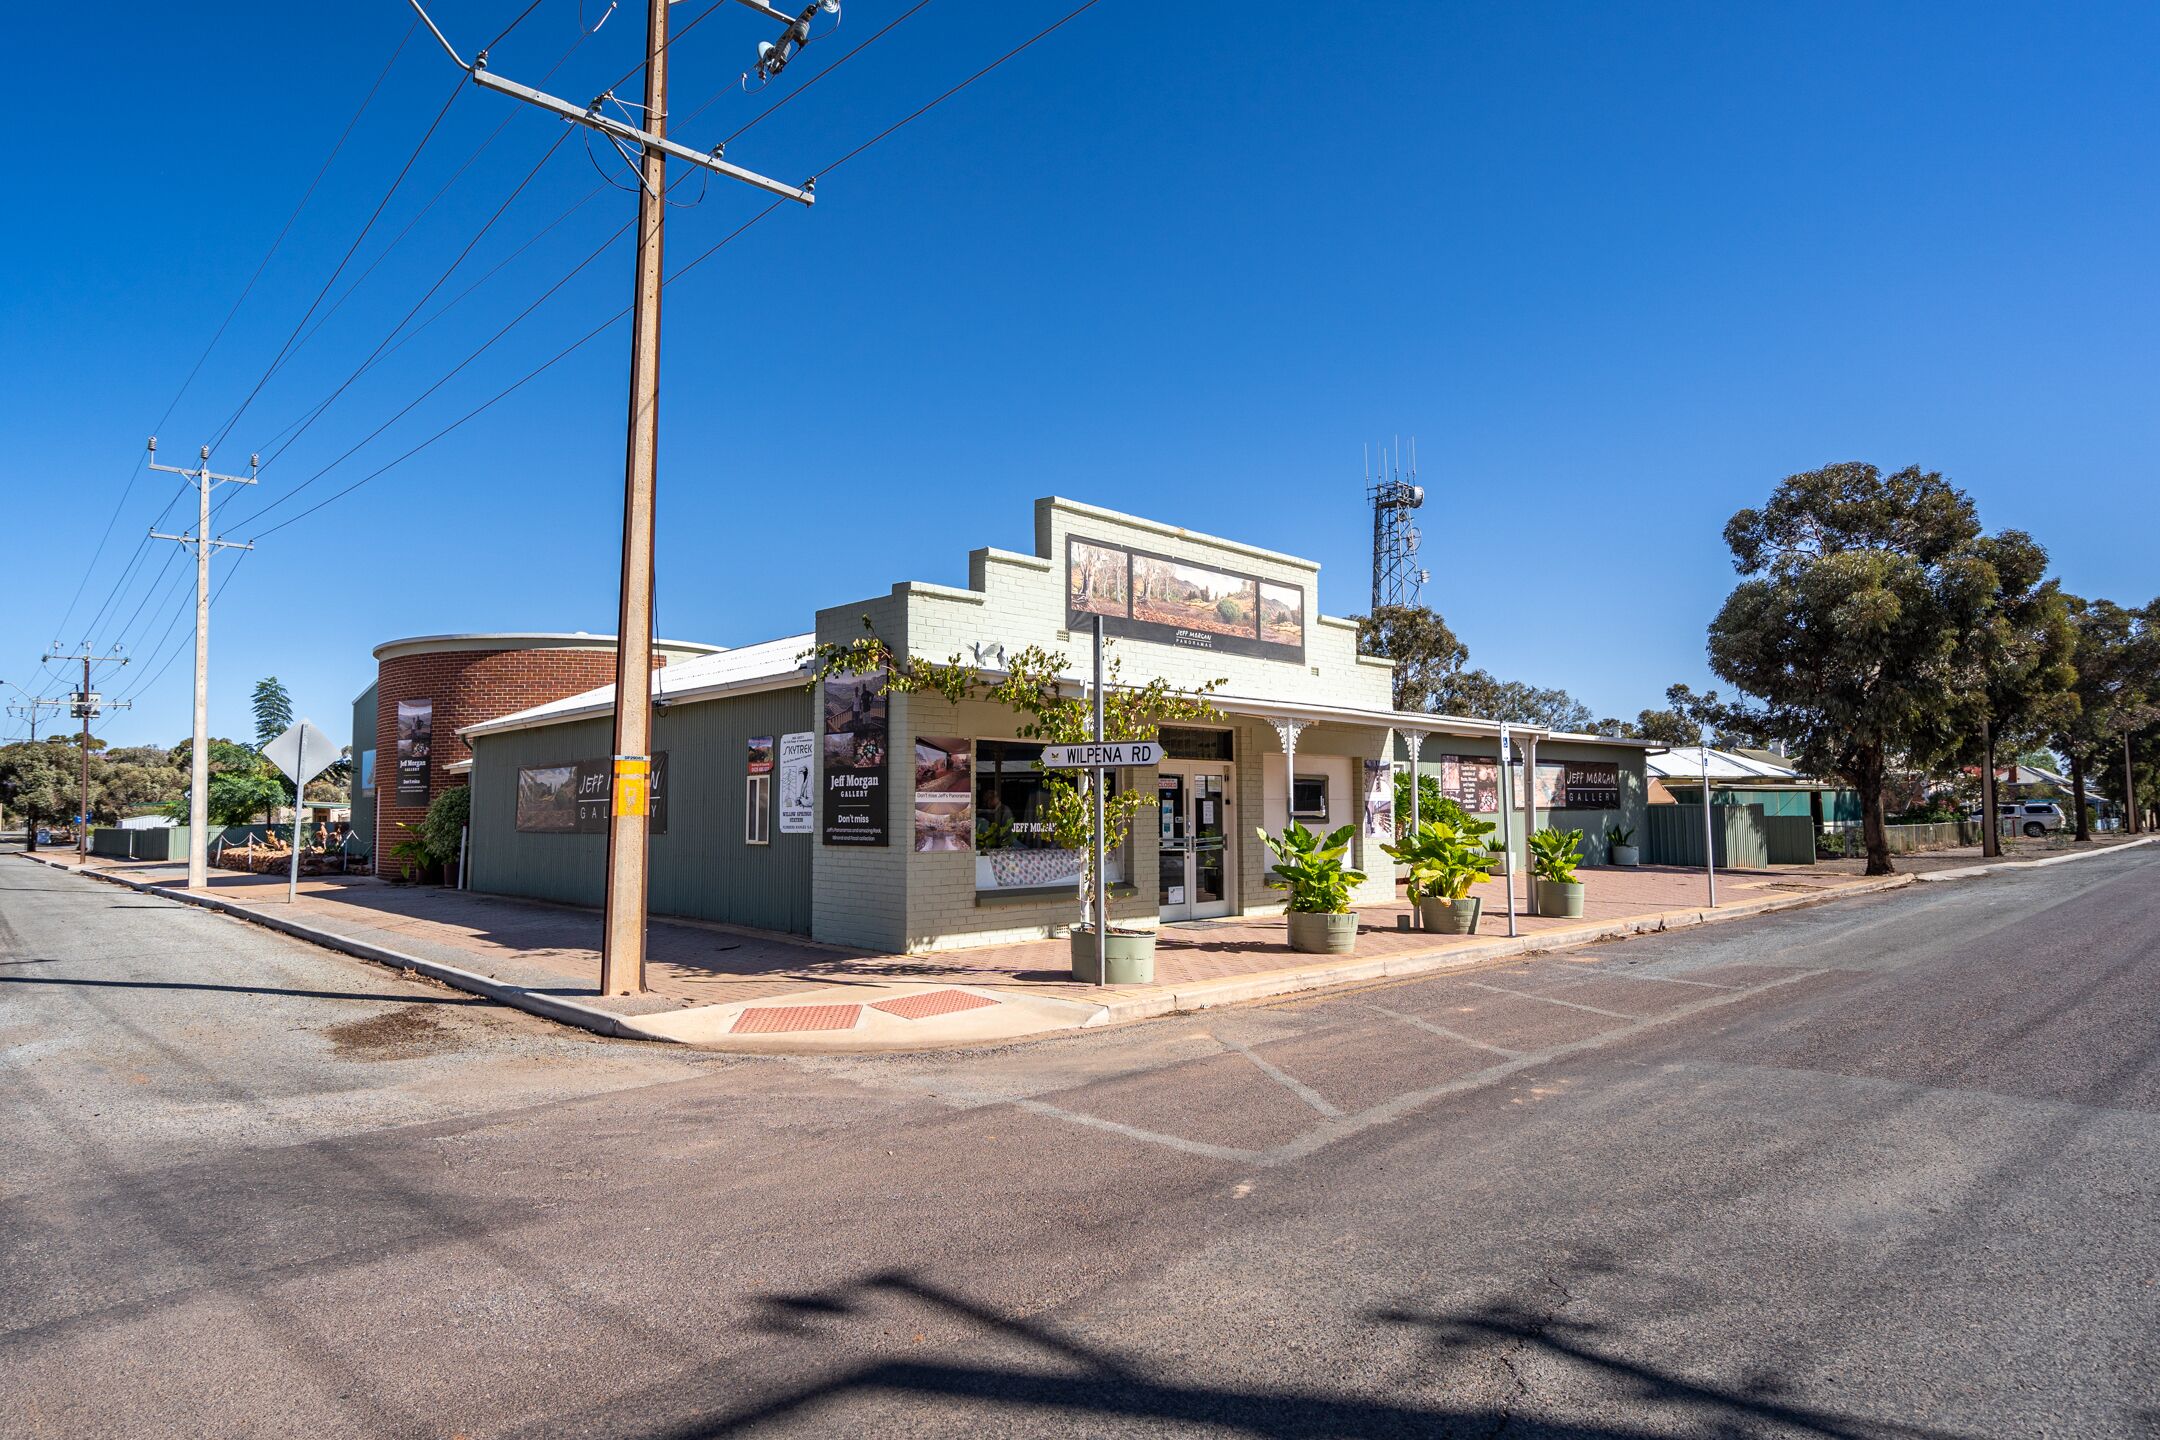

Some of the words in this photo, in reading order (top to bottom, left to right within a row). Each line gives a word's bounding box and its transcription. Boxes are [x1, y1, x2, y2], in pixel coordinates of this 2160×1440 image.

[1190, 632, 1212, 640] MORGAN
[1176, 638, 1212, 648] PANORAMAS
[783, 744, 812, 755] SKYTREK
[1066, 746, 1122, 764] WILPENA
[1132, 746, 1152, 762] RD
[830, 775, 845, 790] Jeff
[846, 775, 879, 789] Morgan
[1567, 772, 1584, 784] JEFF
[1586, 772, 1616, 784] MORGAN
[578, 774, 604, 794] JEFF
[1569, 792, 1616, 802] GALLERY
[838, 814, 854, 823] Don't
[854, 814, 869, 823] miss
[1011, 822, 1029, 832] JEFF
